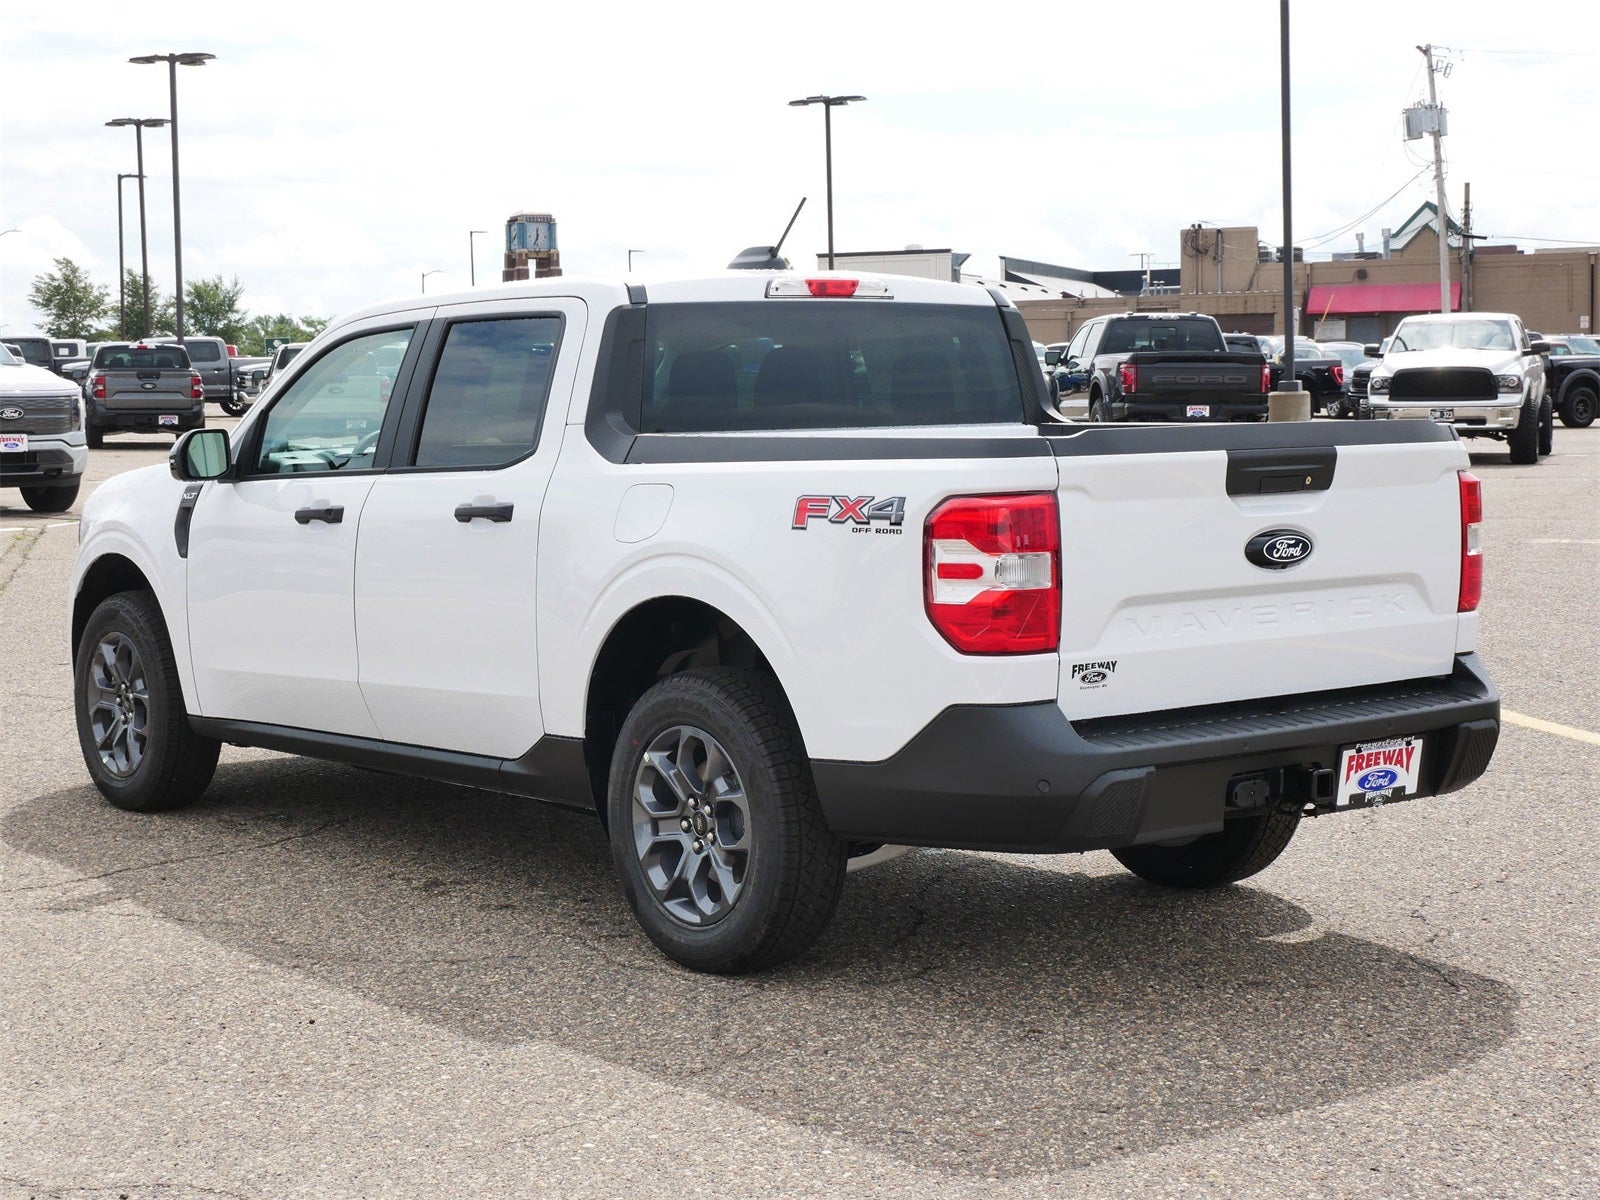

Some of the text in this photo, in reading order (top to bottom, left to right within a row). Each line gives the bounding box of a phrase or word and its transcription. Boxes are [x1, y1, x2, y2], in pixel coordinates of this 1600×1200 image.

[1151, 375, 1247, 384] FORD
[791, 494, 906, 530] FX4
[1273, 539, 1303, 558] Ford
[1124, 592, 1408, 641] MAVERICK
[1071, 660, 1118, 679] FREEWAY
[1345, 746, 1416, 785] FREEWAY
[1364, 771, 1391, 789] Ford
